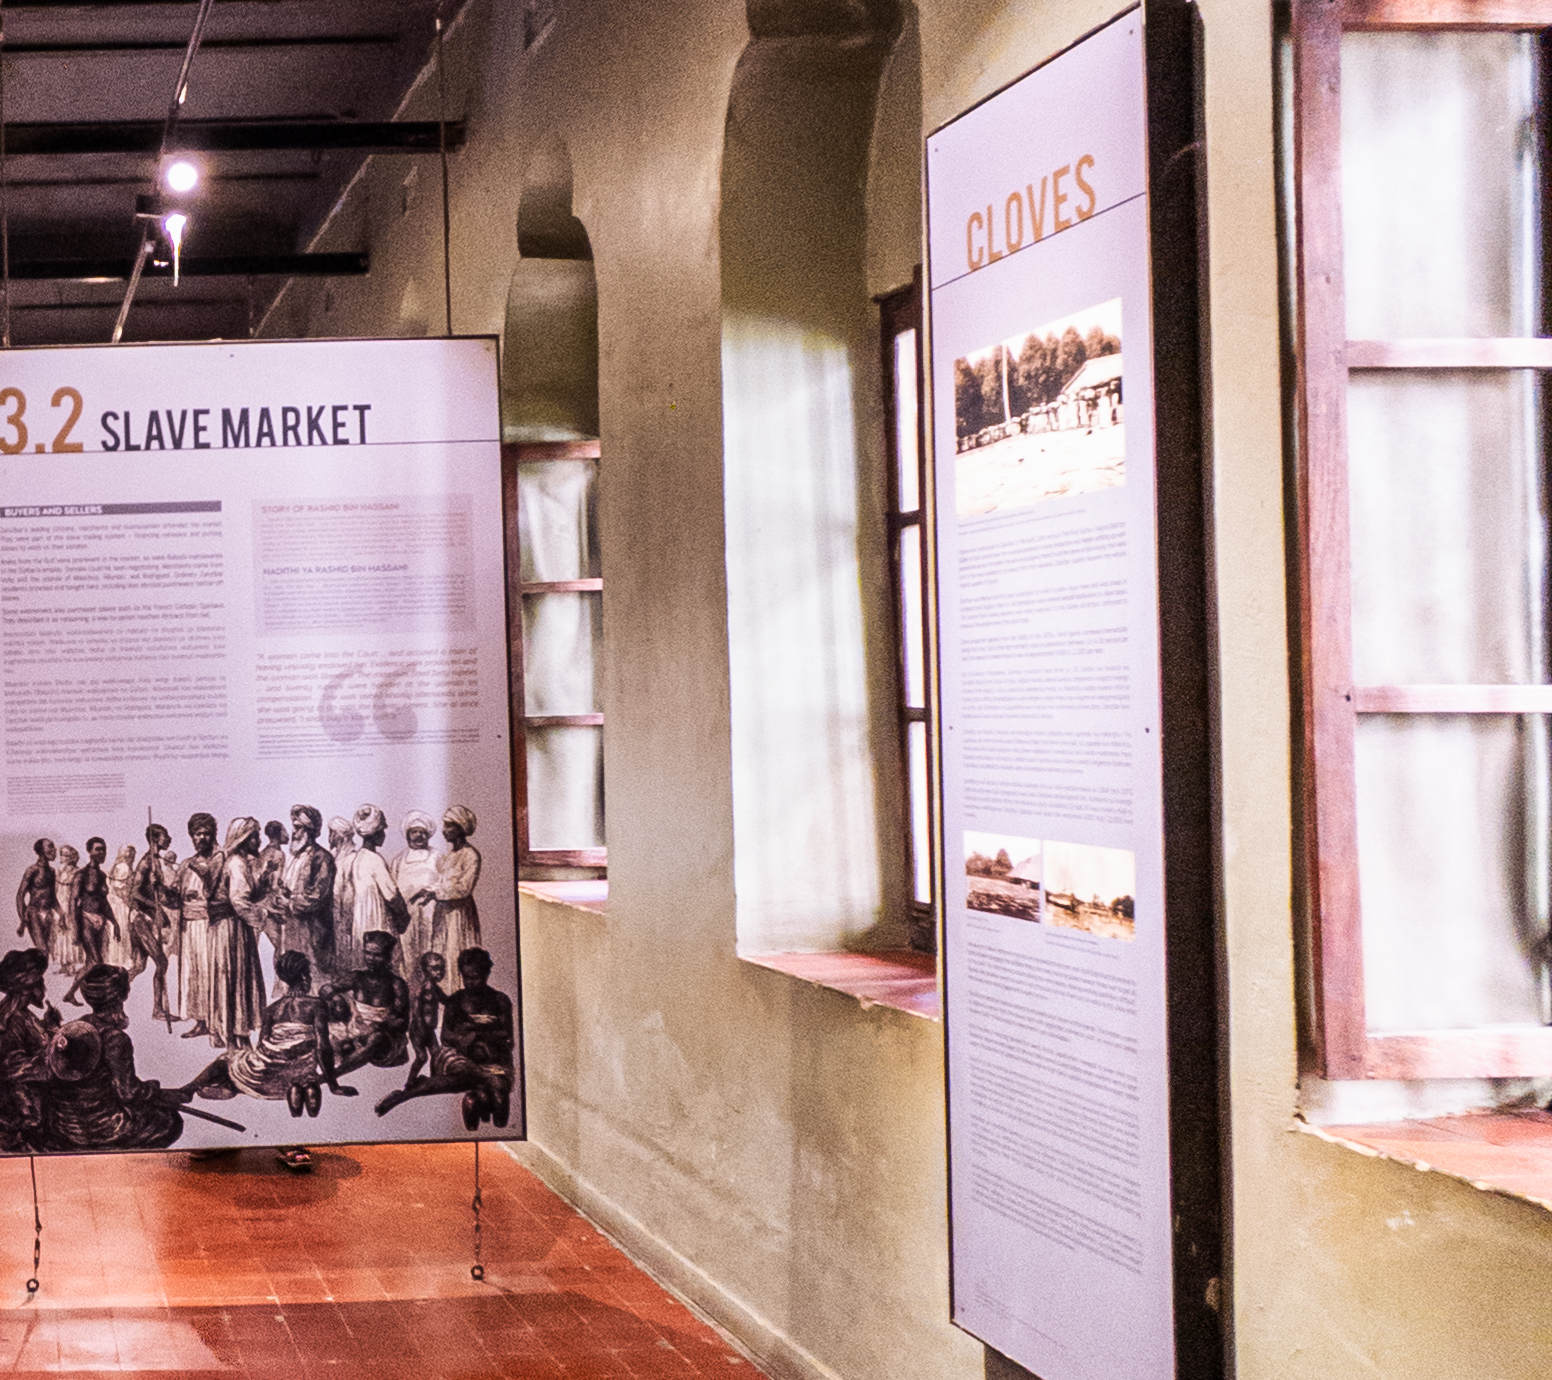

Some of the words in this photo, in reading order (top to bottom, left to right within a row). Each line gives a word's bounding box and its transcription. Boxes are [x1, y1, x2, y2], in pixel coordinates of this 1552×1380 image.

[967, 154, 1098, 273] CLOVES
[101, 408, 211, 452] SLAVE
[222, 404, 372, 448] MARKET
[4, 507, 40, 517] BUYERS
[42, 506, 63, 516] AND
[64, 505, 102, 515] SELLERS
